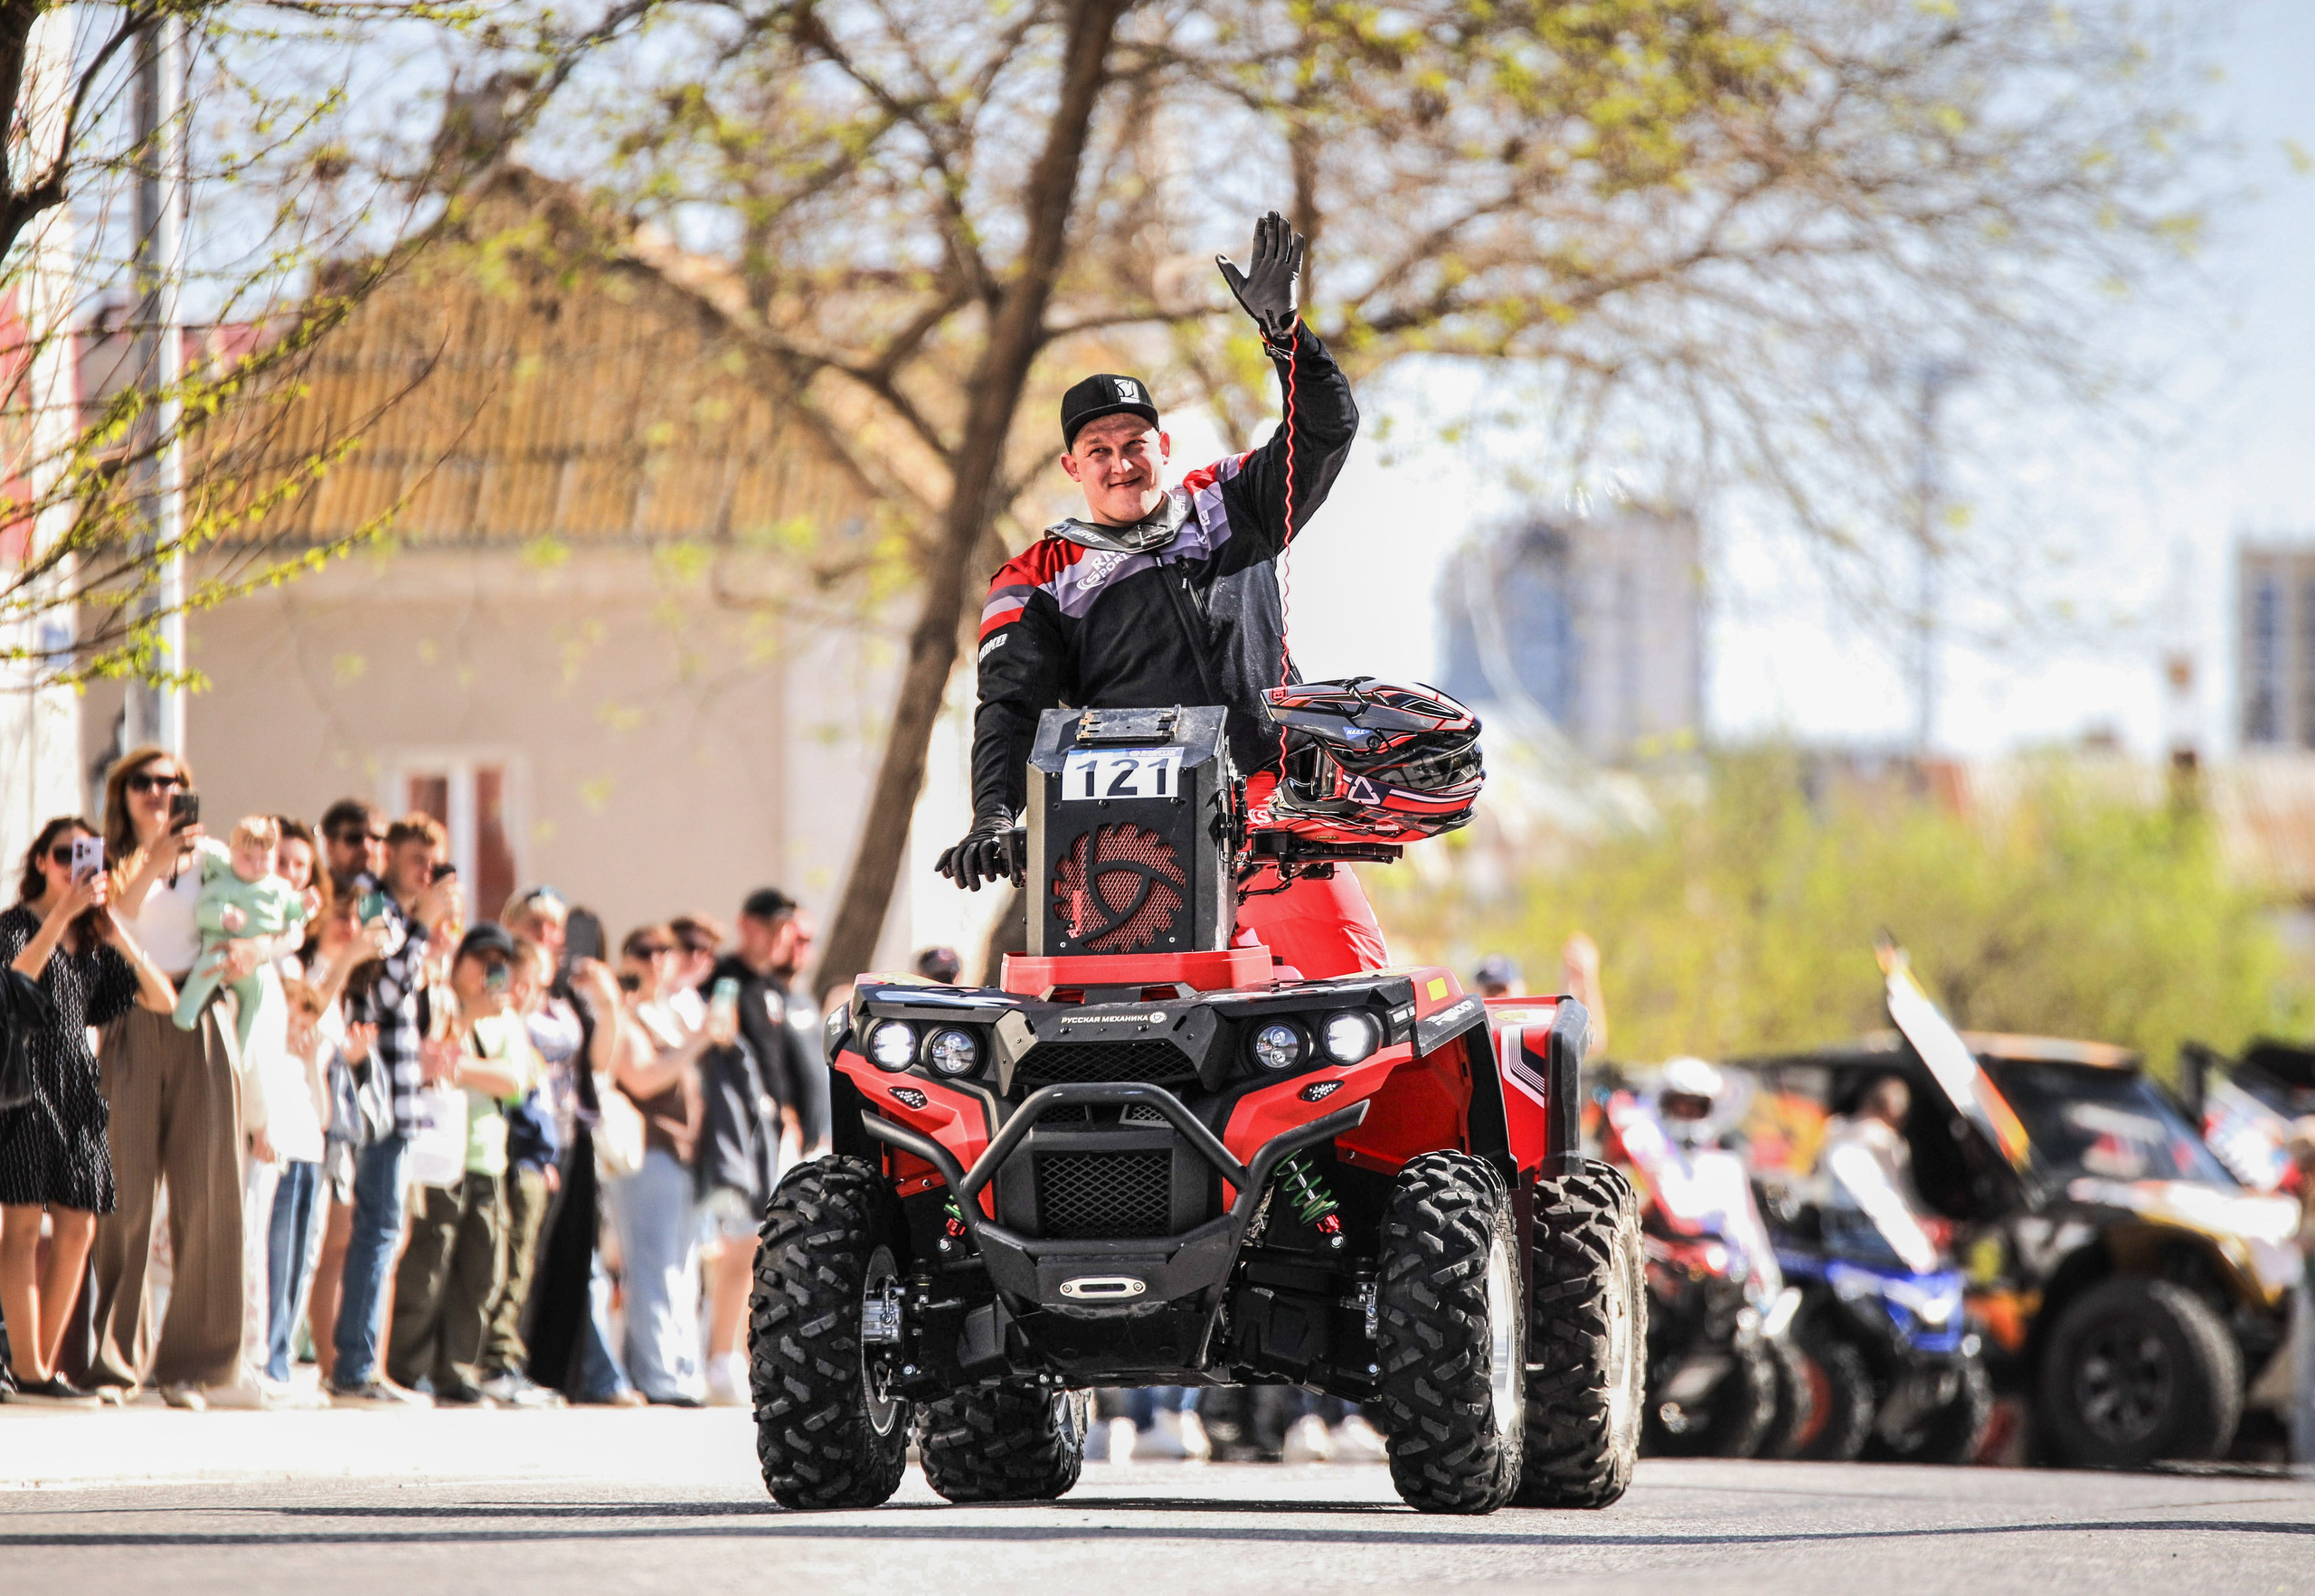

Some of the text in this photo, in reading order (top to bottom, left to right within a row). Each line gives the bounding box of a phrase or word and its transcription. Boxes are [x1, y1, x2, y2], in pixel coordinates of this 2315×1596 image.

[1071, 528, 1105, 543] LEATT
[1086, 552, 1129, 583] SPORT
[1076, 758, 1169, 797] 121
[1101, 1015, 1148, 1023] МЕХАНИКА
